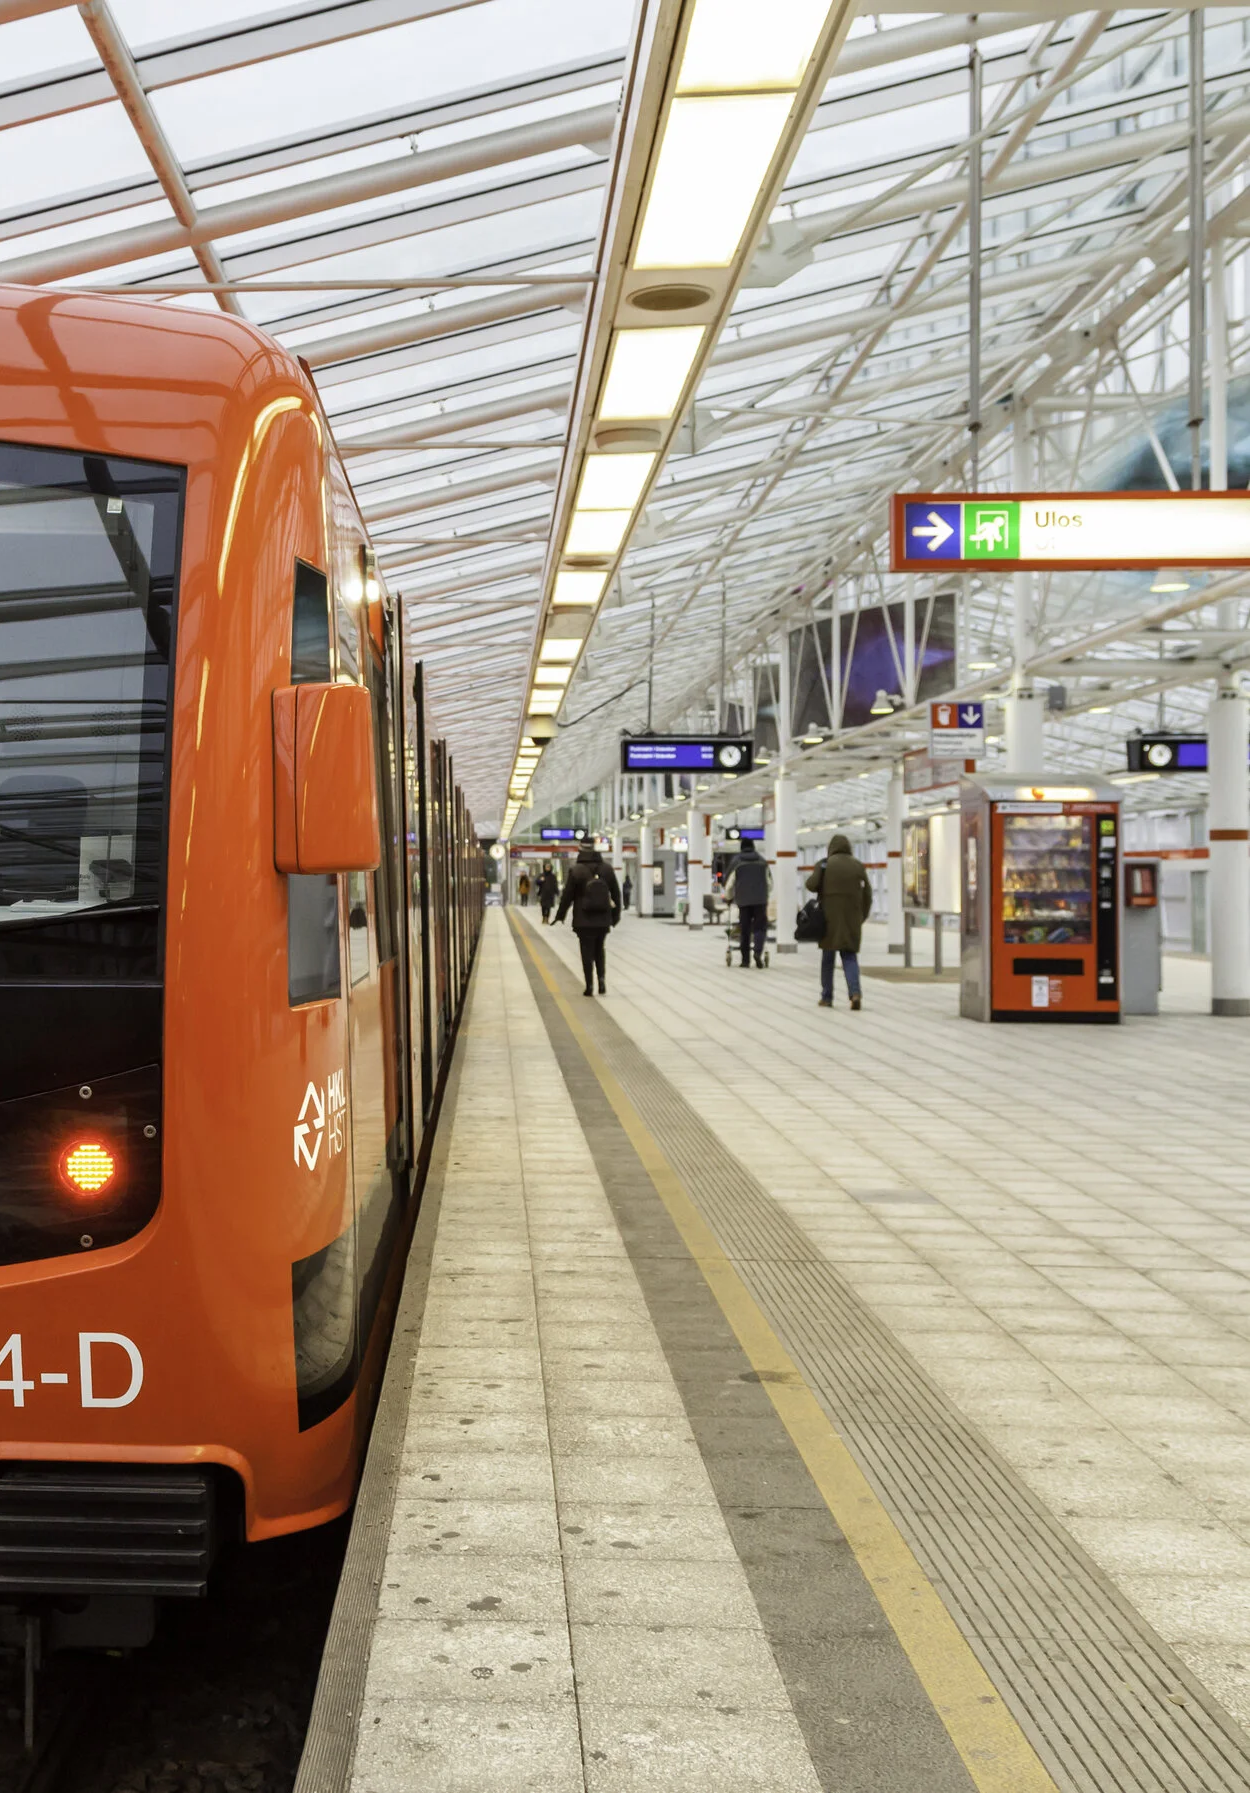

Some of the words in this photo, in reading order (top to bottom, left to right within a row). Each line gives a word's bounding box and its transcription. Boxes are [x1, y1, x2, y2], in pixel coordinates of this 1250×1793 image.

[1035, 511, 1083, 528] Ulos
[327, 1068, 346, 1115] HKL
[328, 1108, 347, 1159] HST
